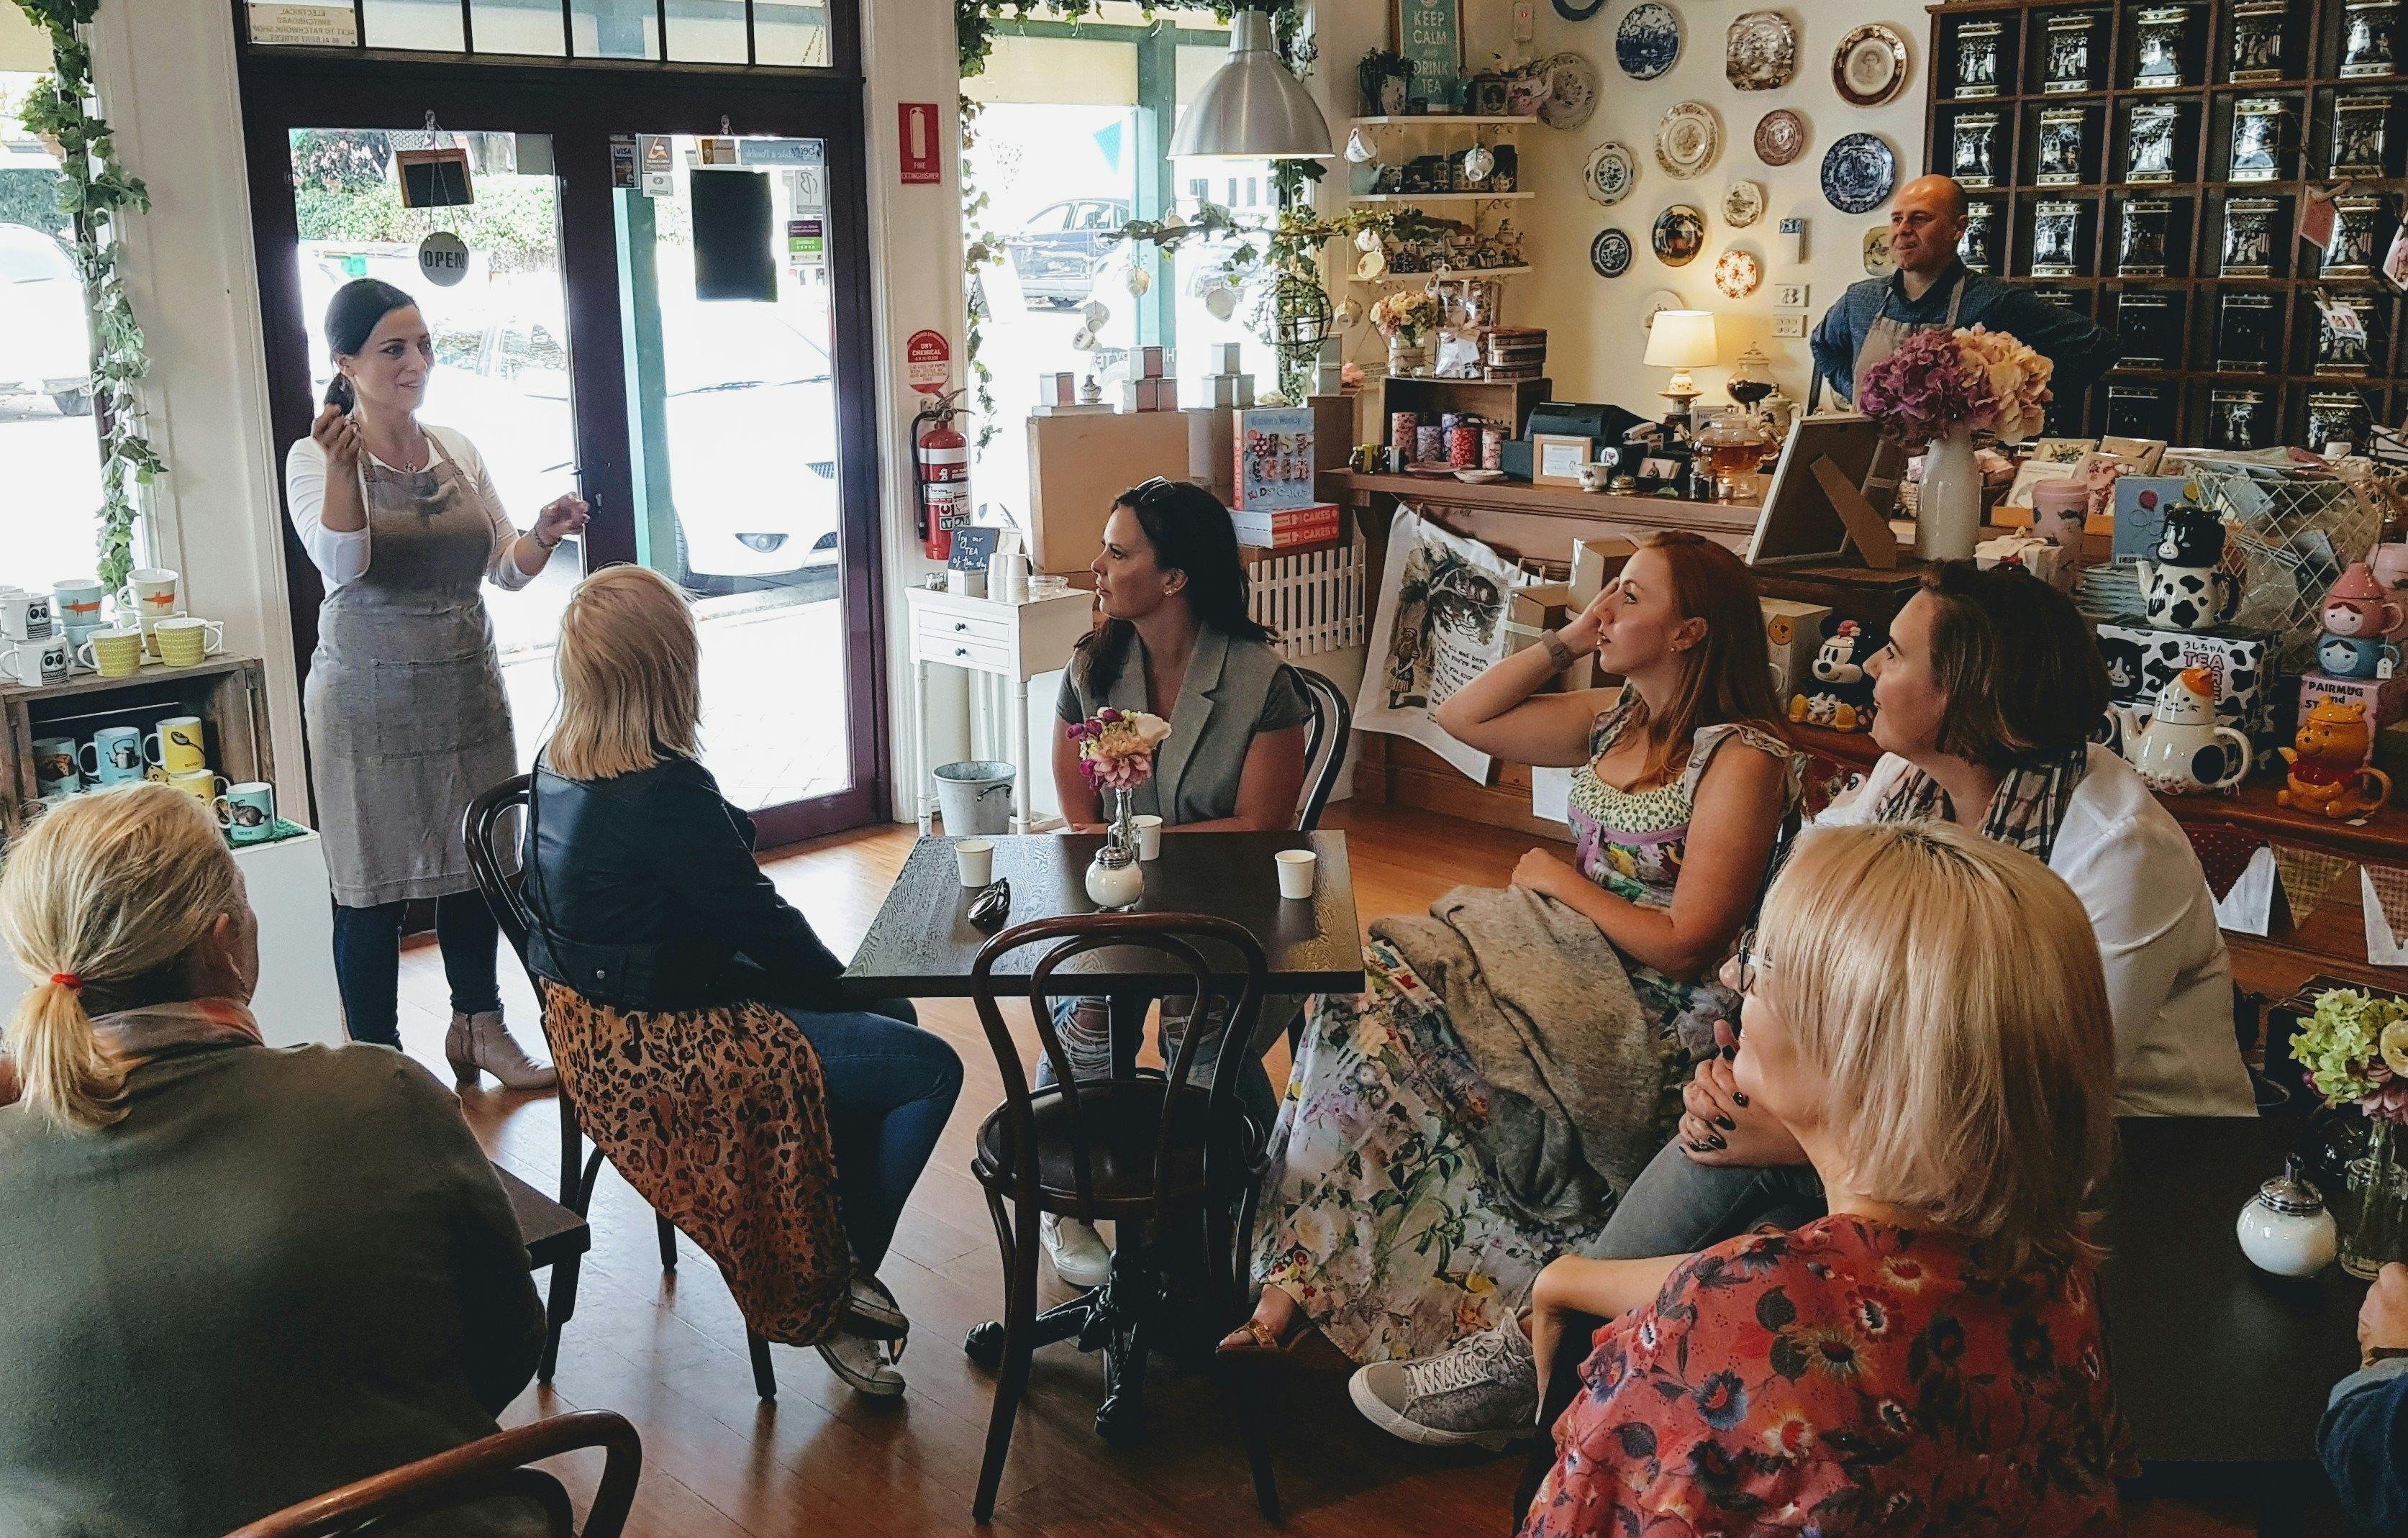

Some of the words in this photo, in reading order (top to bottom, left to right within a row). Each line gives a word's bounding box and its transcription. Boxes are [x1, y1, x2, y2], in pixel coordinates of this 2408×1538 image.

[1414, 11, 1445, 27] KEEP
[1414, 29, 1447, 44] CALM
[1413, 60, 1448, 76] DRINK
[1422, 78, 1442, 94] TEA
[424, 250, 465, 268] OPEN
[1303, 509, 1331, 523] CAKES
[957, 530, 968, 549] Try
[1303, 527, 1331, 540] CAKES
[953, 555, 960, 568] of
[2183, 651, 2225, 671] TEA
[2308, 681, 2364, 698] PAIRMUG
[2328, 695, 2345, 704] nd
